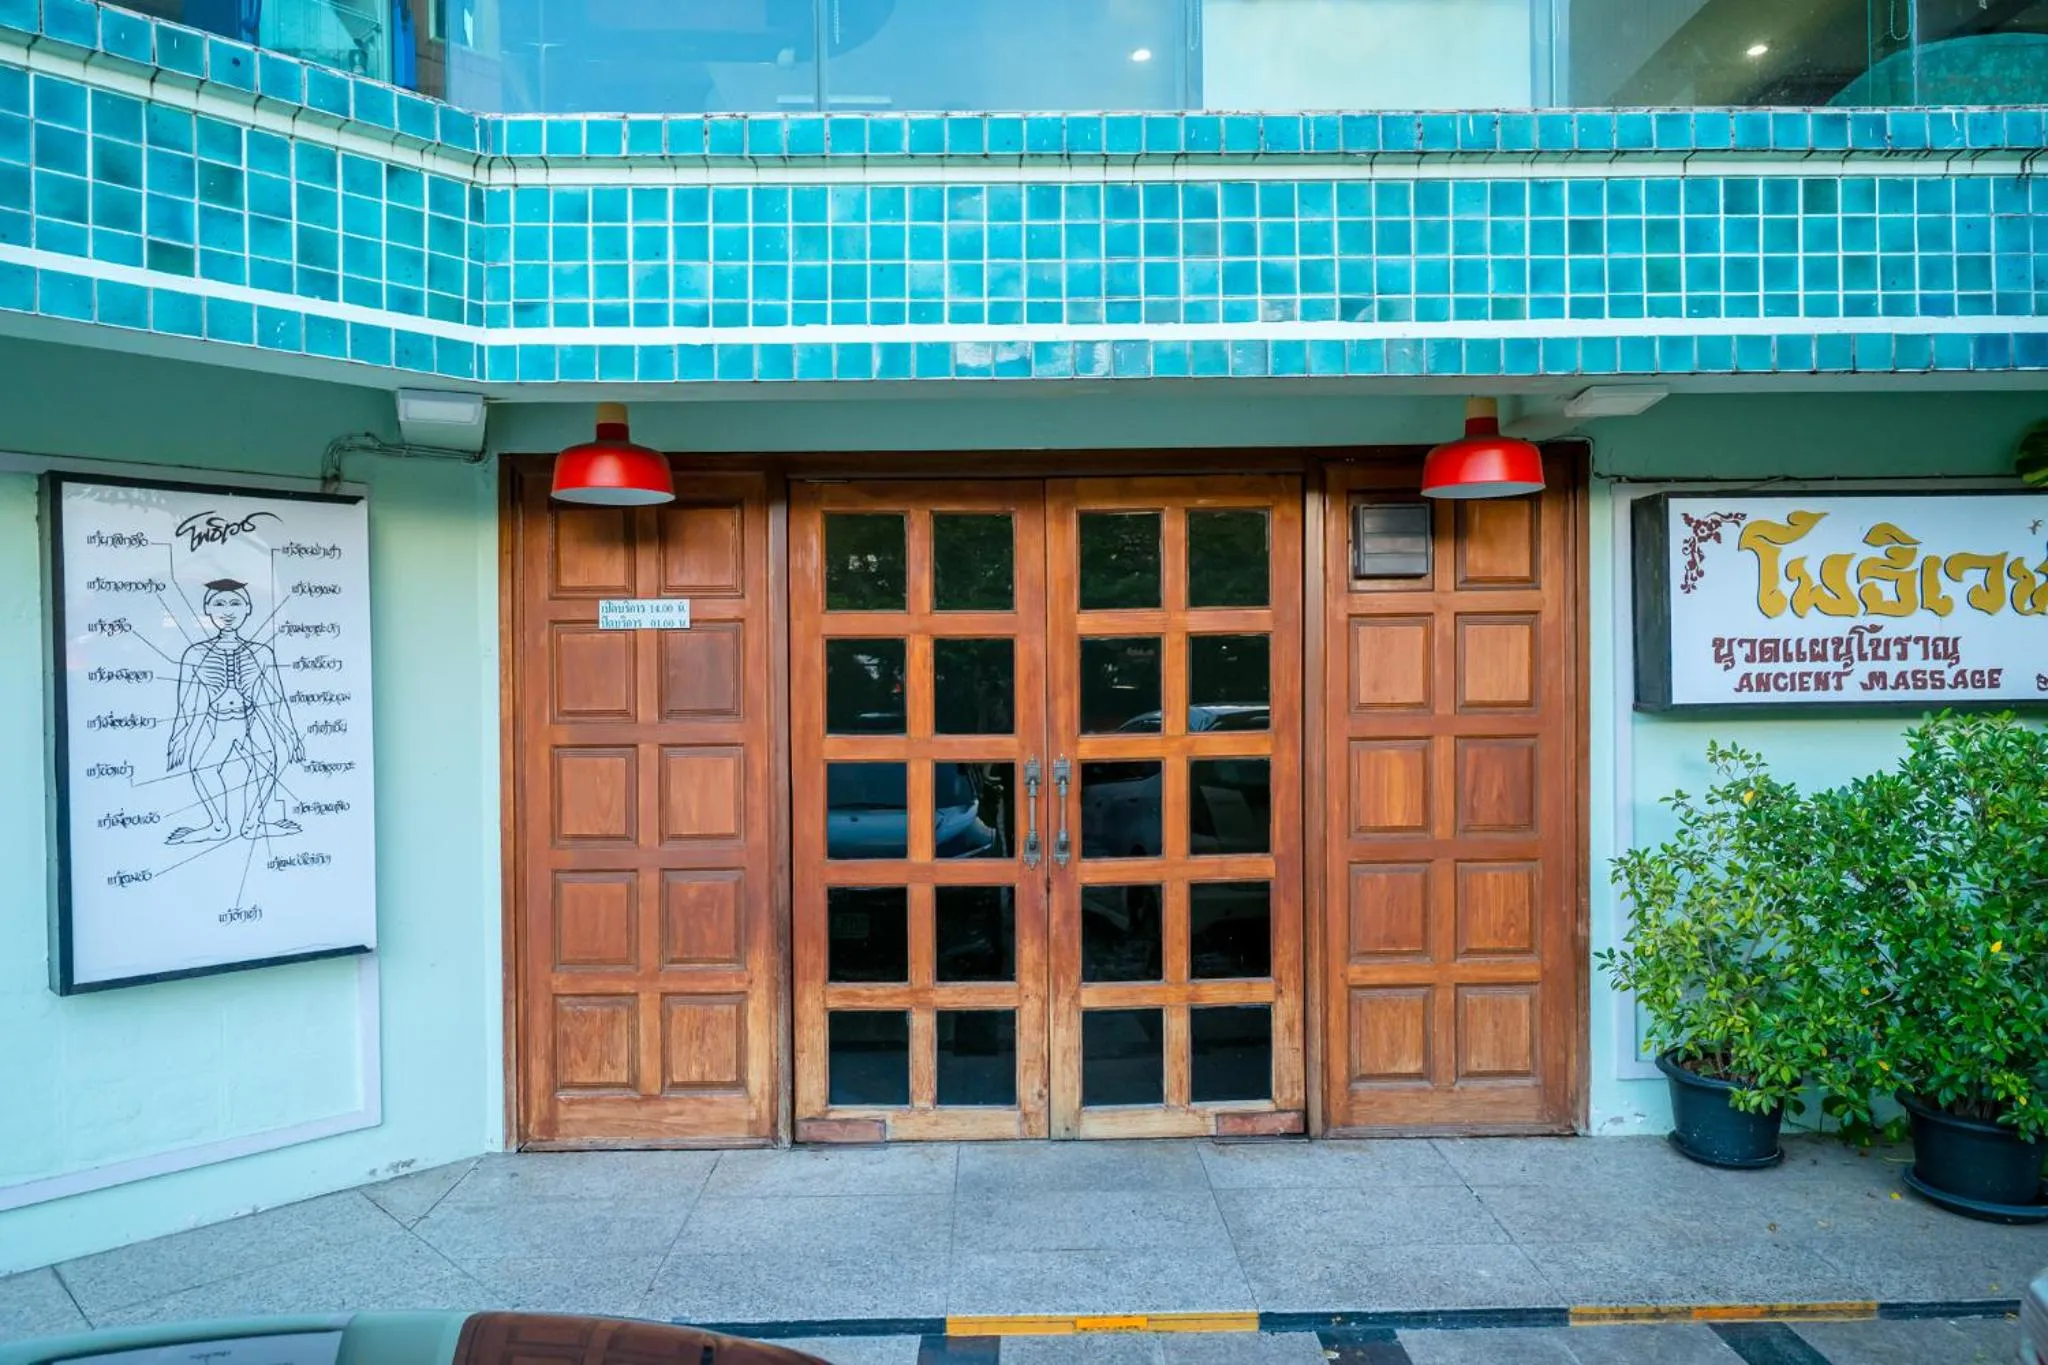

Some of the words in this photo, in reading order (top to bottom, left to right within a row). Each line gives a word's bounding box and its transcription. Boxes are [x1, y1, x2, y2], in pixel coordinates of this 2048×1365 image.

[1712, 624, 1961, 675] นวดแผนโบราณ
[1734, 669, 1853, 693] ANCIENT
[1860, 668, 2004, 691] MASSAGE
